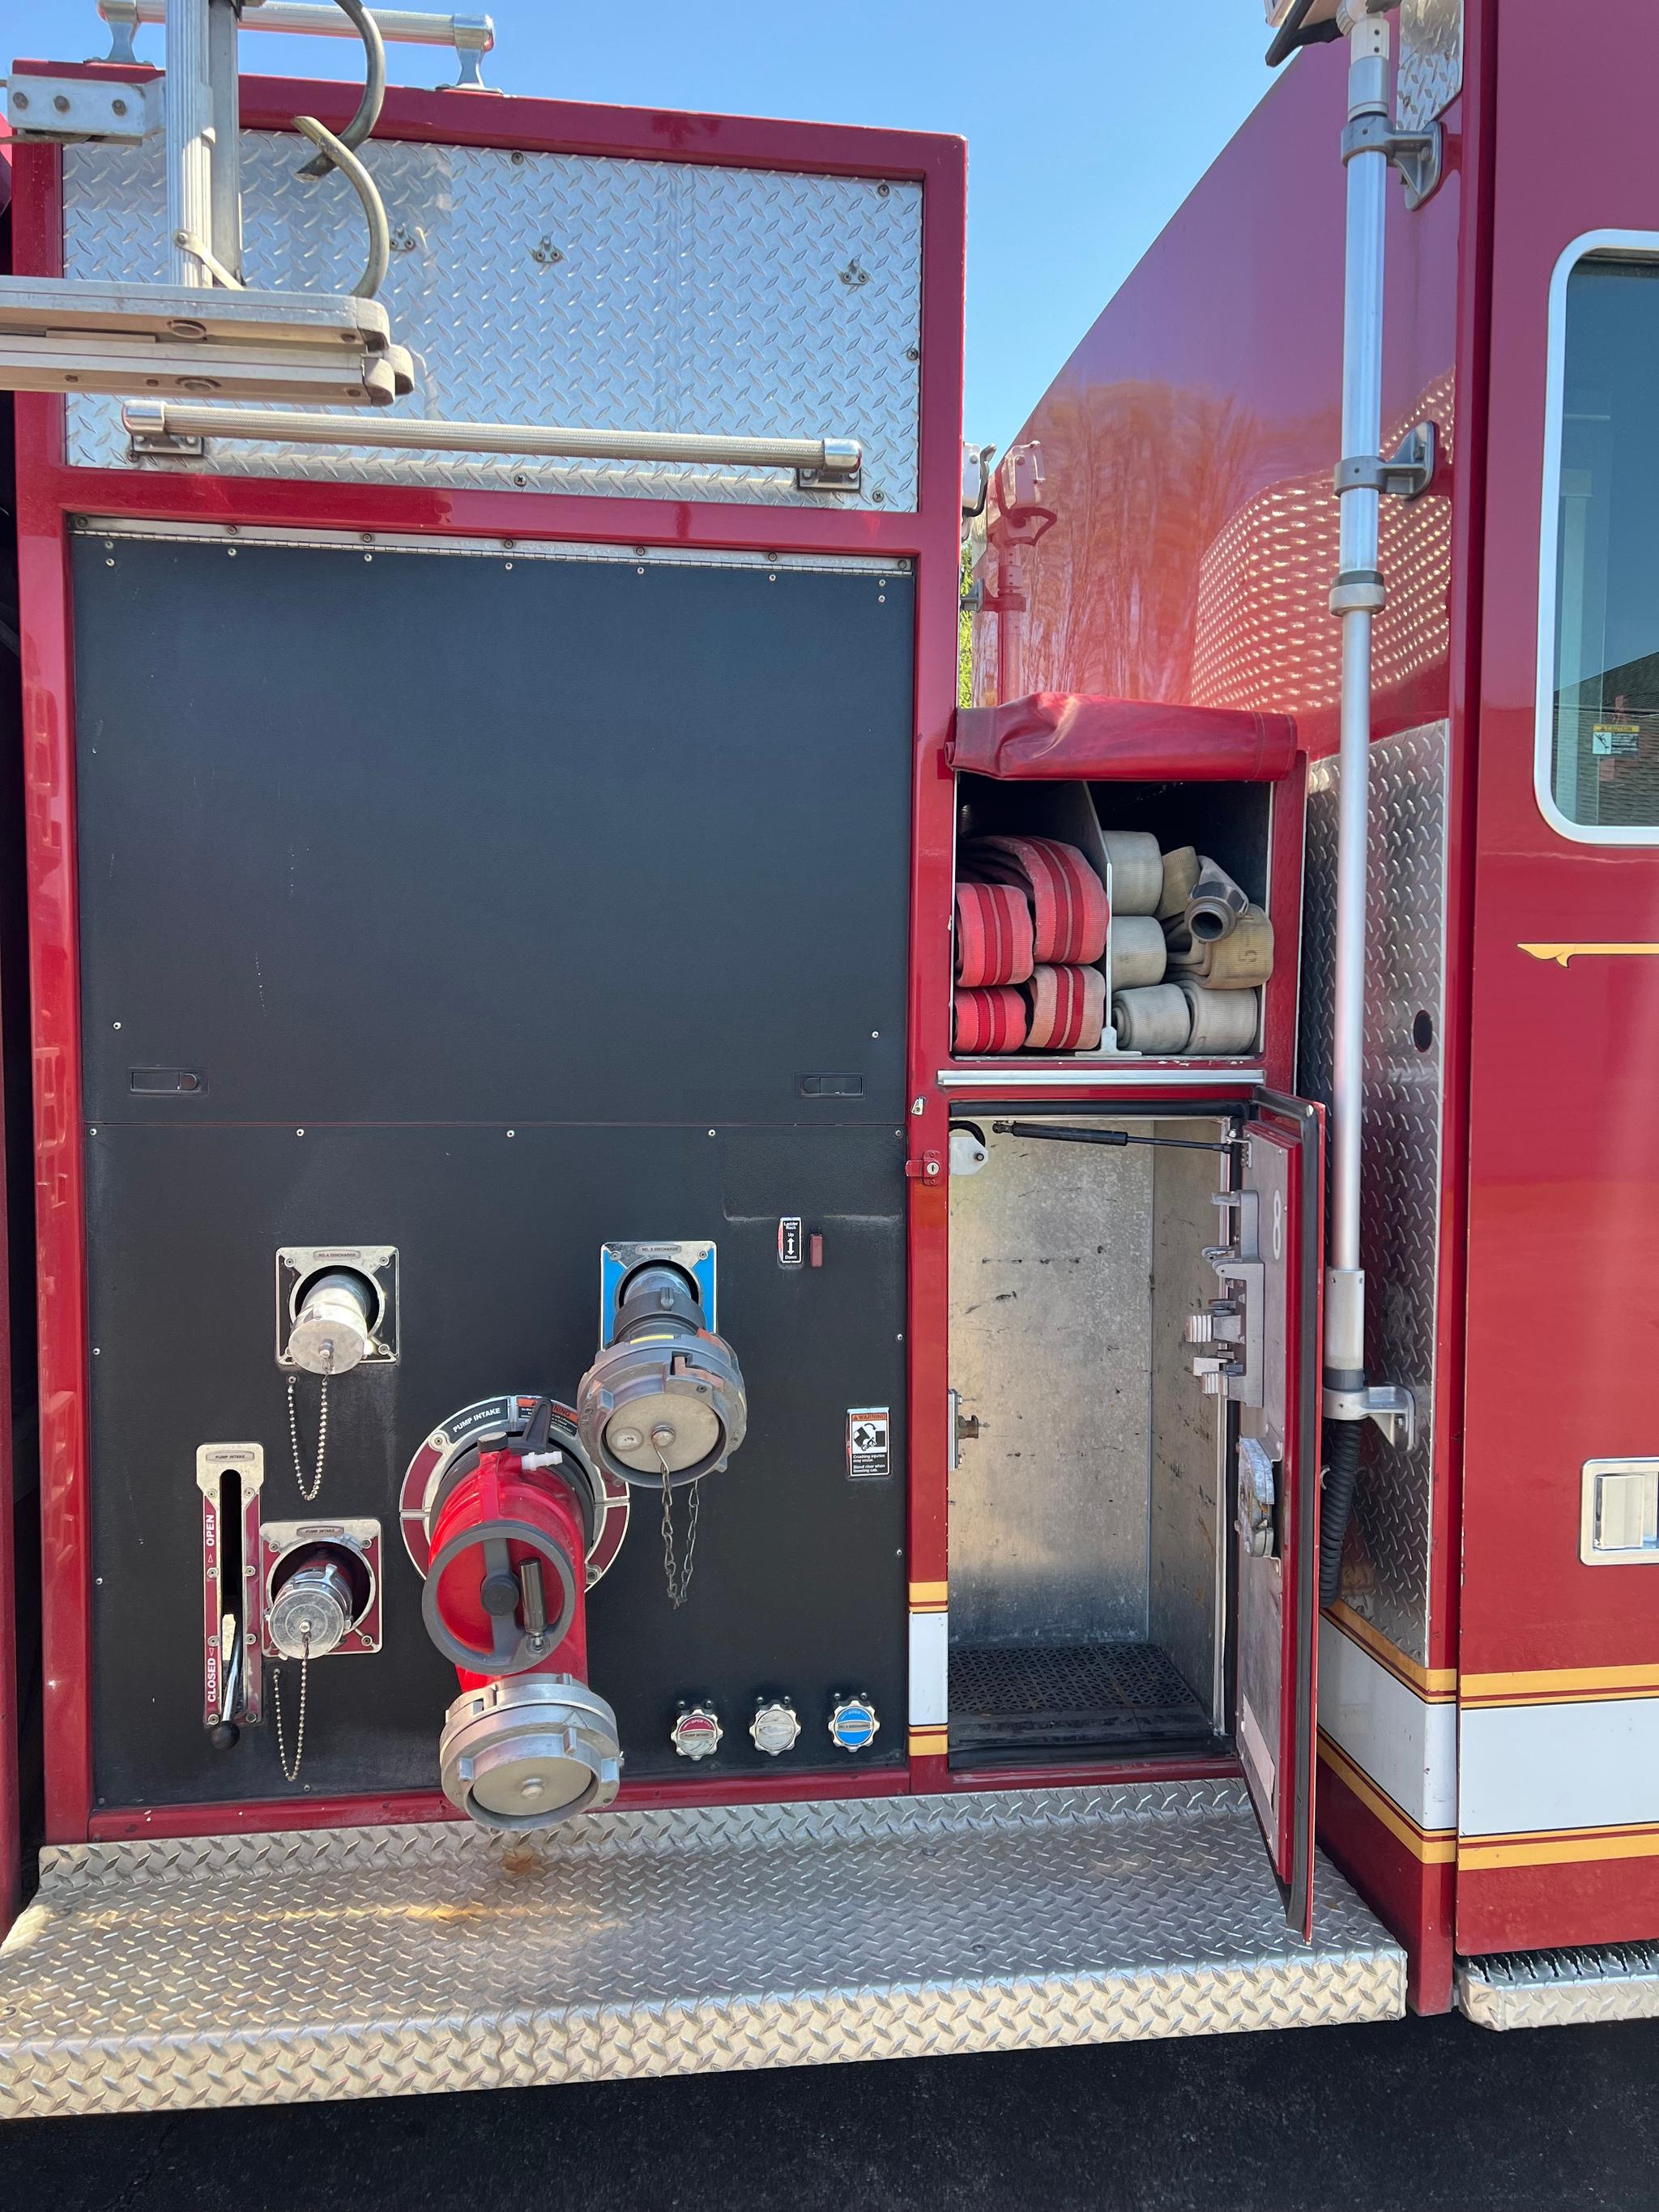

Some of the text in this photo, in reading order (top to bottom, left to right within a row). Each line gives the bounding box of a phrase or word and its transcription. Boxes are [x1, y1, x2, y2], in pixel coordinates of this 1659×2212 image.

[1273, 1189, 1282, 1261] 8
[452, 1407, 501, 1433] PUMP INTAKE
[206, 1514, 215, 1547] OPEN
[207, 1657, 216, 1703] CLOSED
